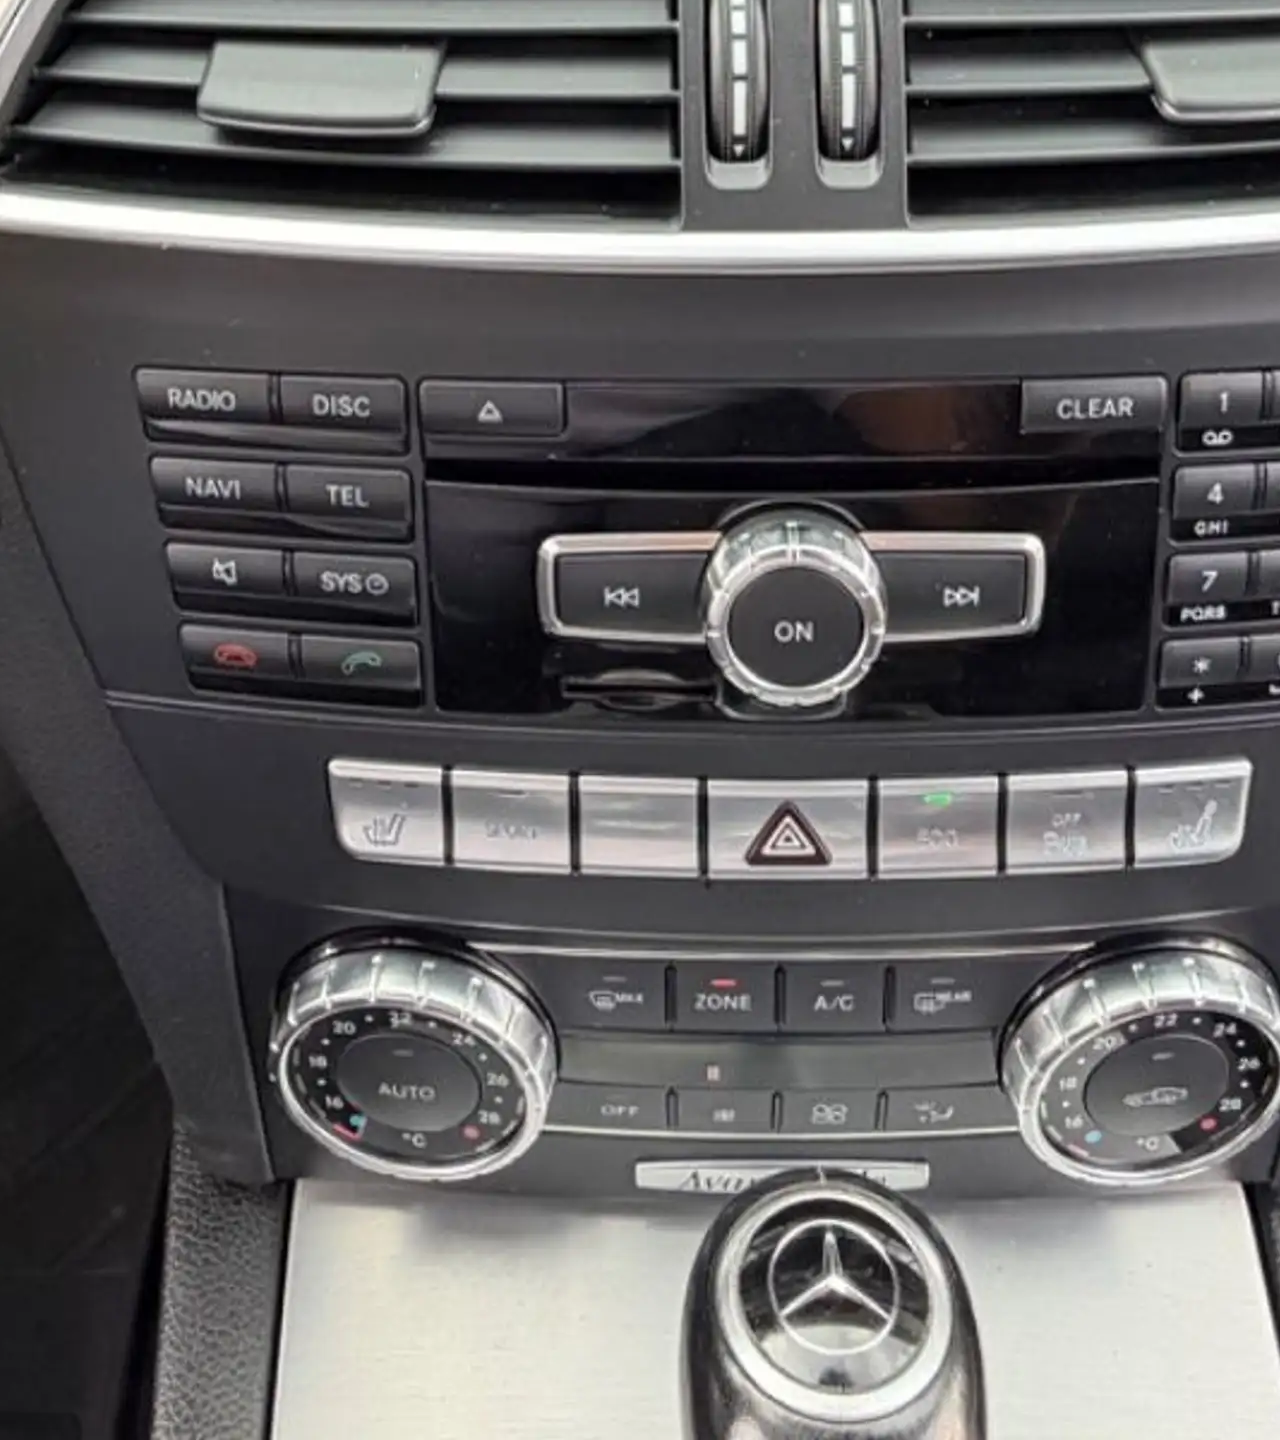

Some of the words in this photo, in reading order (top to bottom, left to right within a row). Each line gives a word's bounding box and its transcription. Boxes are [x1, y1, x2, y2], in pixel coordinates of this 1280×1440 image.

[168, 389, 235, 411] RADIO
[313, 394, 370, 417] DISC
[1057, 398, 1134, 419] CLEAR
[1219, 393, 1228, 411] 1
[186, 477, 241, 499] NAVI
[327, 484, 368, 507] TEL
[1207, 483, 1223, 504] 4
[1194, 521, 1228, 537] GHI
[321, 571, 362, 592] SYS
[1202, 571, 1218, 591] 7
[1181, 605, 1226, 621] PQRS
[774, 621, 813, 642] ON
[695, 994, 751, 1012] ZONE
[815, 994, 854, 1012] A/C
[332, 1020, 356, 1036] 20
[378, 1081, 435, 1101] AUTO
